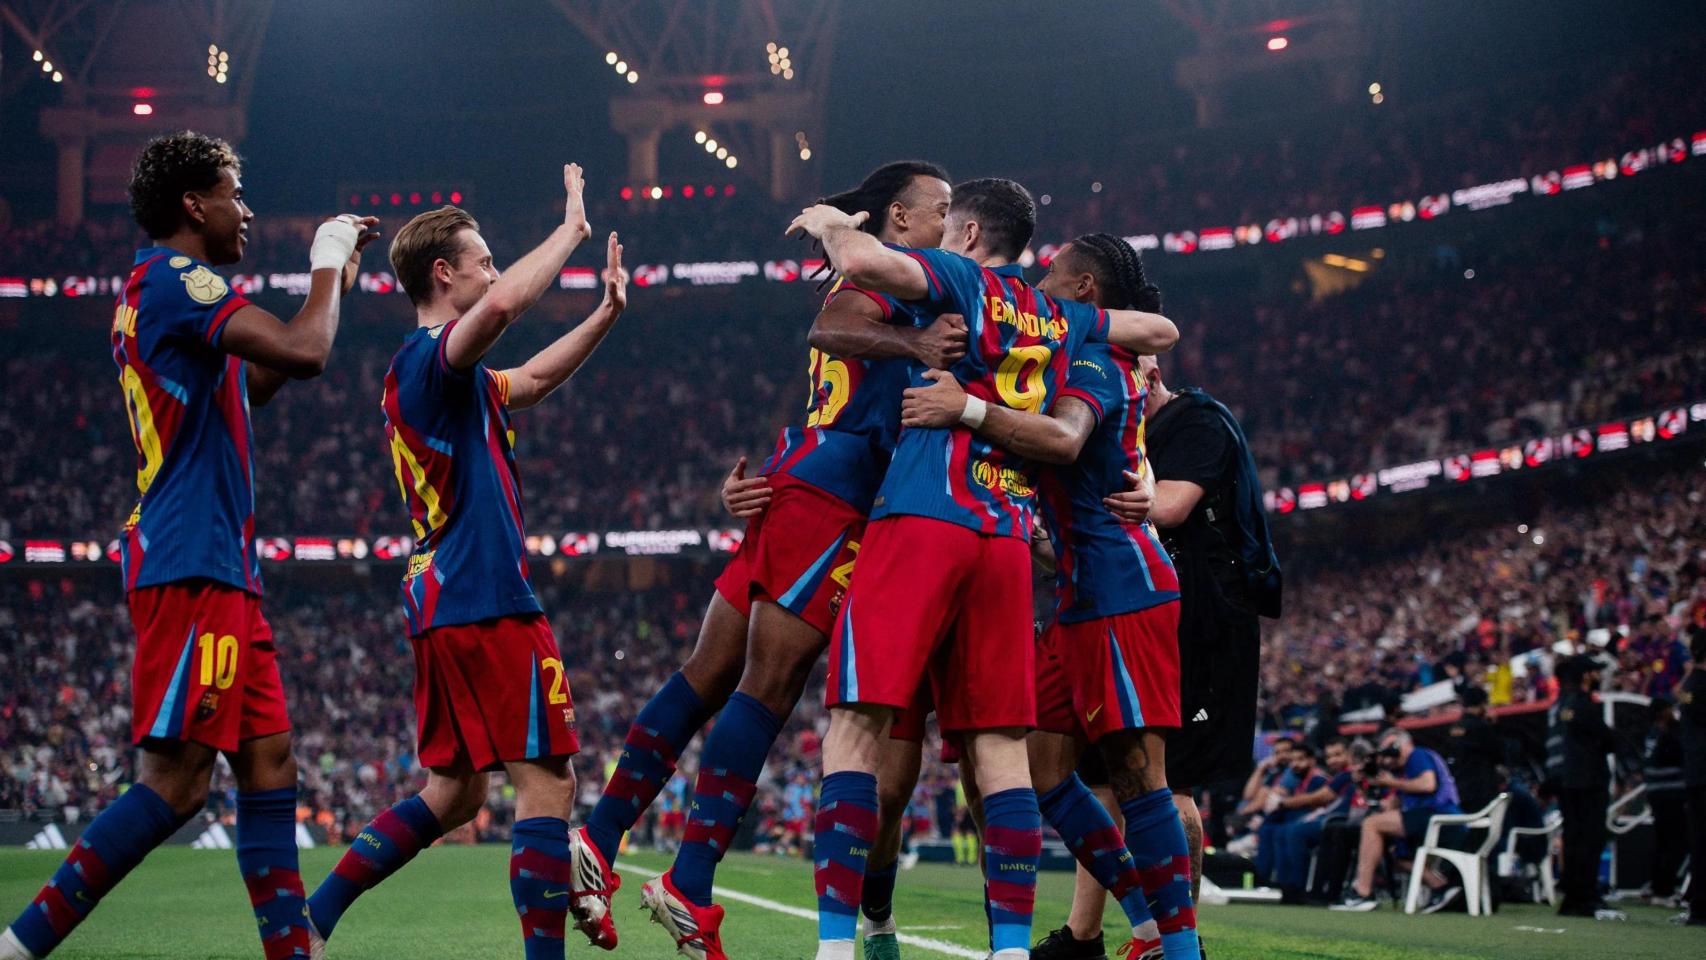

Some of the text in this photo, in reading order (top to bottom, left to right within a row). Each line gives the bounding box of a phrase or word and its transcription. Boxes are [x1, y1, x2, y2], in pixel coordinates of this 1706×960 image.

[996, 345, 1051, 415] 9
[119, 363, 164, 495] 0
[830, 540, 861, 591] 2
[199, 633, 239, 690] 10
[542, 657, 568, 705] 2
